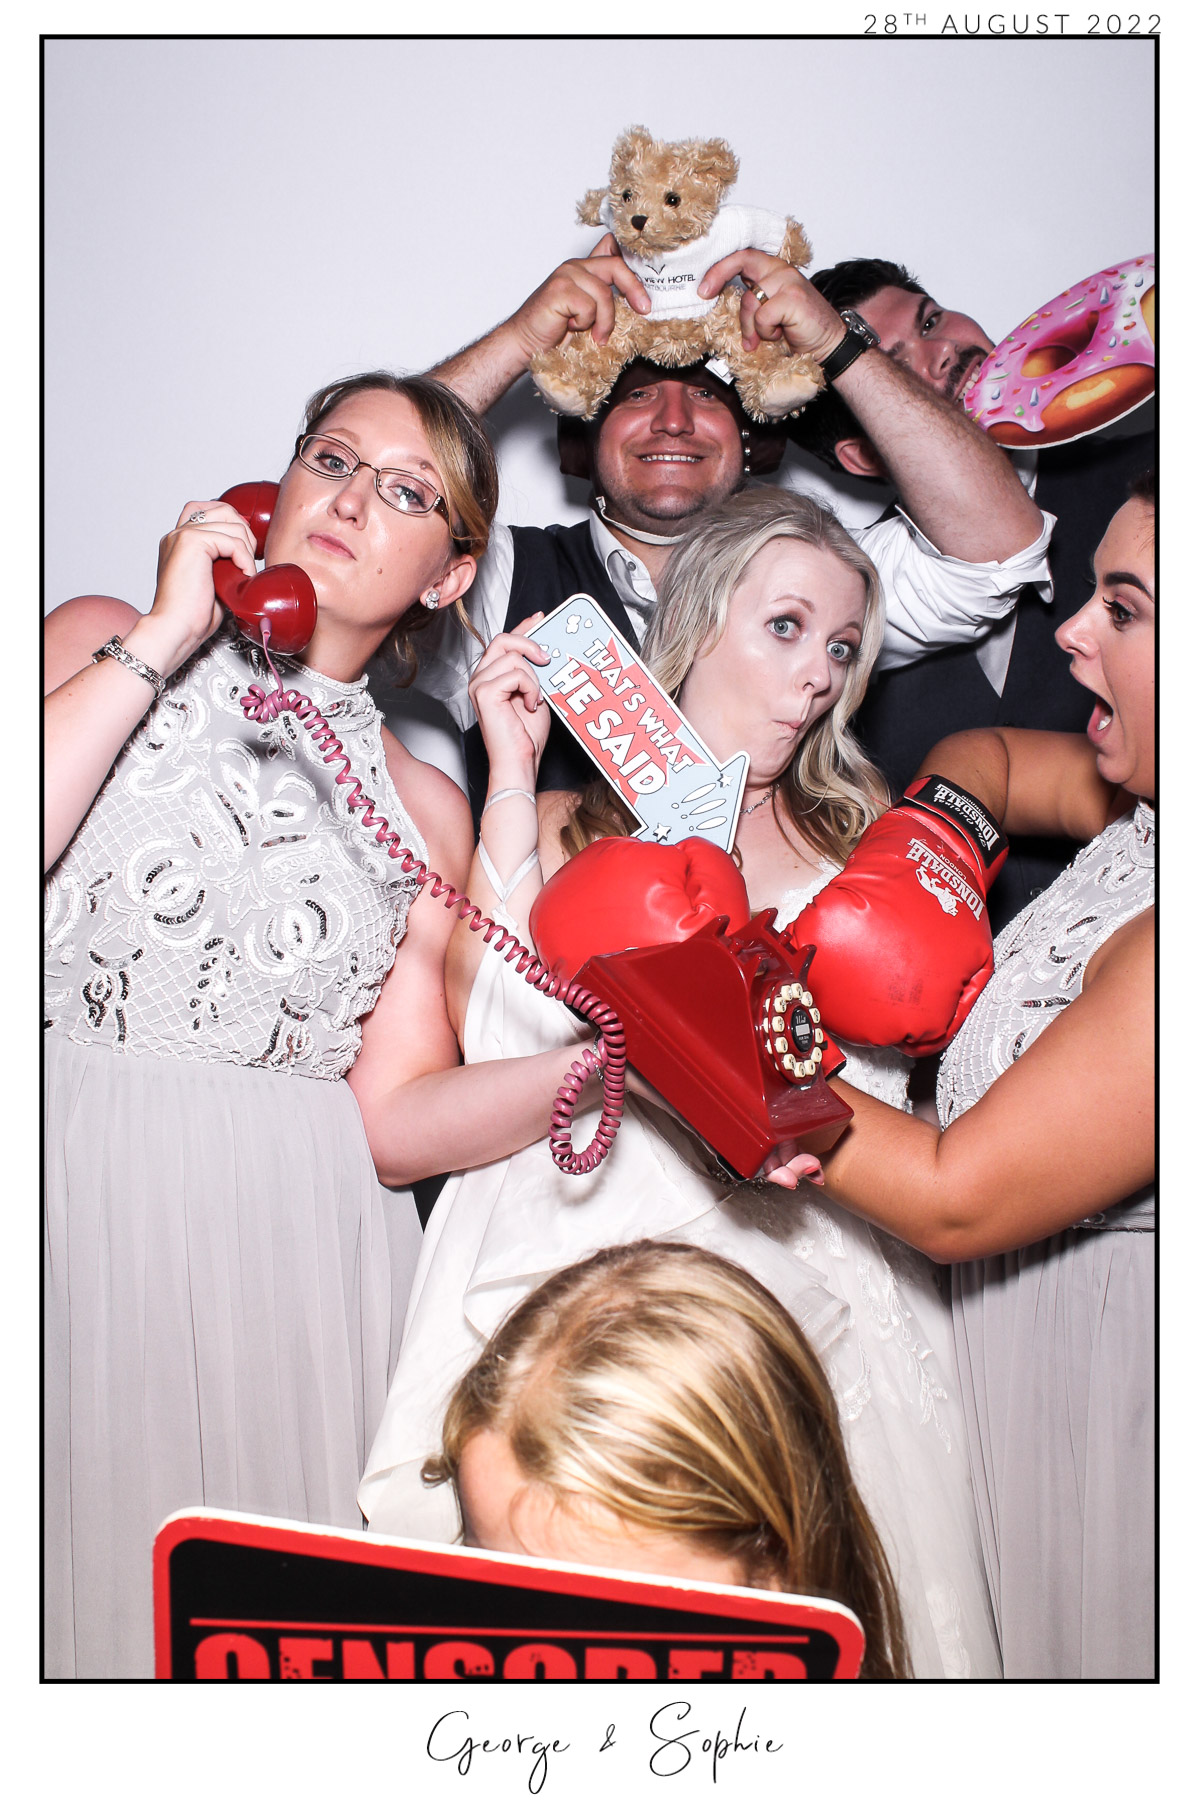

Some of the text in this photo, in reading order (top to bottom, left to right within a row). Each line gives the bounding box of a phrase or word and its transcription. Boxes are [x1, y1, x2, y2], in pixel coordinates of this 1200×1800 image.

[667, 274, 696, 284] HOTEL
[549, 658, 666, 795] HE SAID
[583, 638, 695, 774] THAT'S WHAT
[934, 783, 1000, 851] LONSDALE
[905, 837, 985, 921] LONSDALE
[939, 853, 967, 880] LONDON
